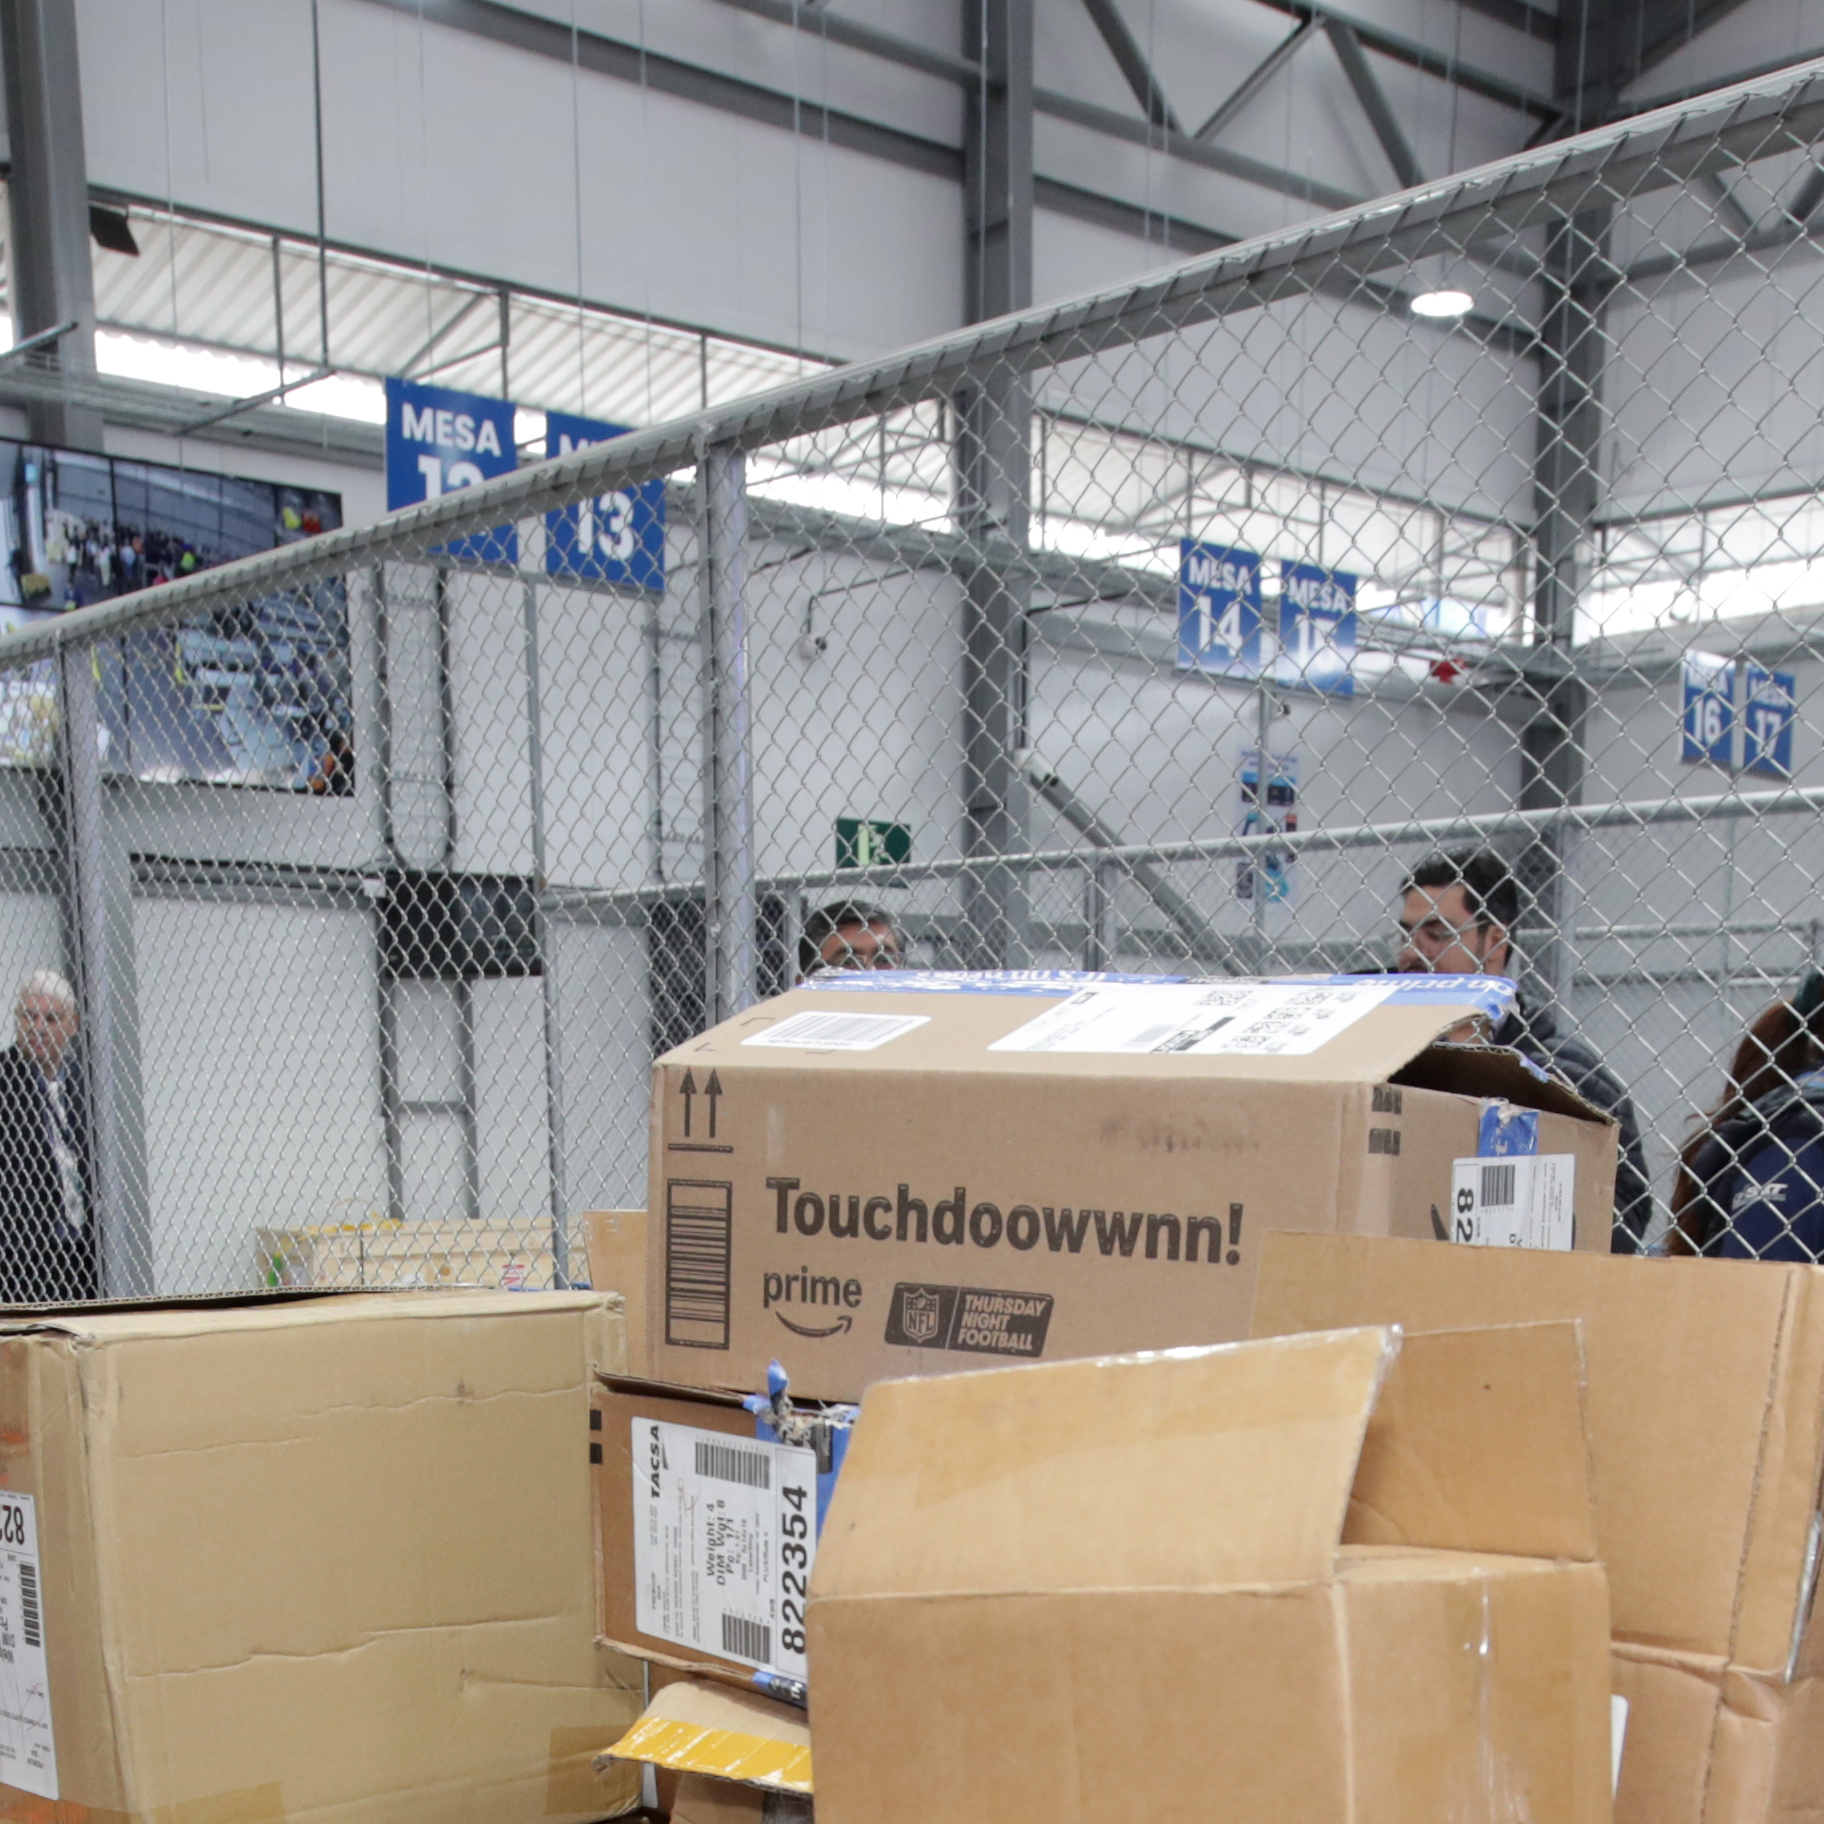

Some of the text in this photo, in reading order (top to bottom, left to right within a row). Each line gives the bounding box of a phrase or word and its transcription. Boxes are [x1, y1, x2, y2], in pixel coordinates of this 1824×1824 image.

[402, 402, 502, 457] MESA
[578, 491, 634, 561] 13
[1188, 555, 1252, 595] MESA
[1288, 576, 1347, 614] MESA
[1197, 595, 1243, 657] 14
[1693, 697, 1722, 742] 16
[1756, 710, 1782, 754] 17
[765, 1177, 1243, 1266] Touchdoowwnn!
[762, 1266, 863, 1309] prime
[962, 1295, 1047, 1316] THURSDAY
[907, 1313, 935, 1332] NFL
[957, 1328, 1033, 1351] FOOTBALL
[961, 1312, 1011, 1331] NIGHT
[650, 1425, 661, 1498] TACSA
[705, 1503, 717, 1577] Weight: 4
[717, 1551, 725, 1585] DIM
[782, 1484, 808, 1654] 822354
